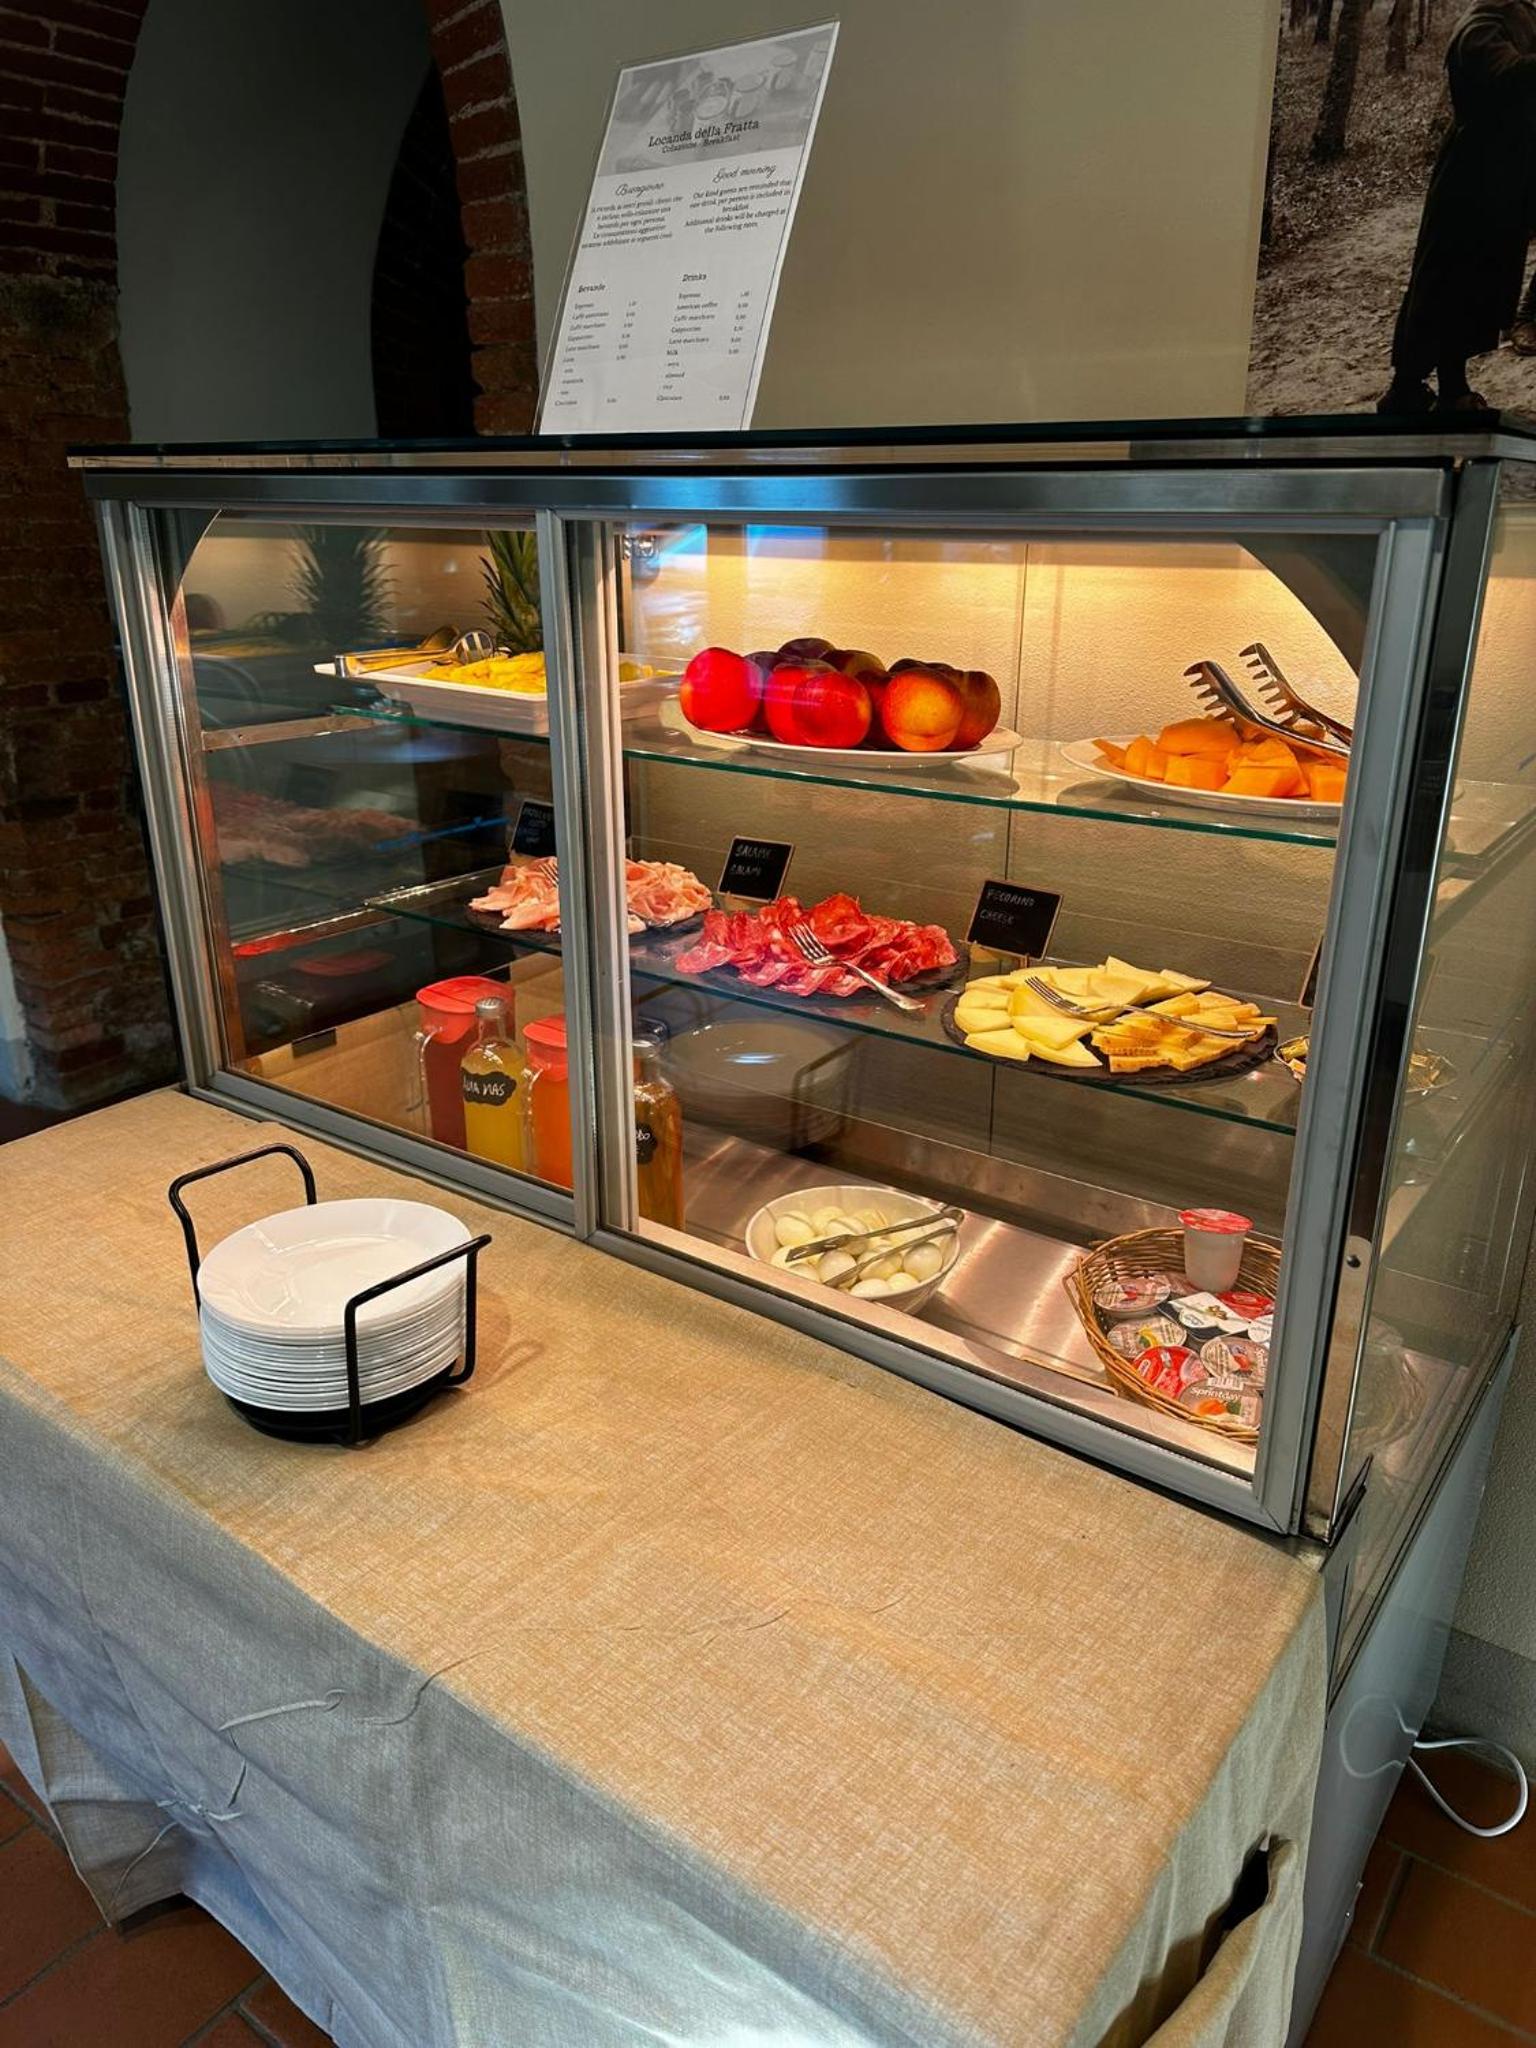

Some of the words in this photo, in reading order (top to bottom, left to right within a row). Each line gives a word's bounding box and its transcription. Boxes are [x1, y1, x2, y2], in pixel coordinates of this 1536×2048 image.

[648, 131, 693, 147] Locanda
[695, 126, 721, 139] della
[724, 120, 759, 134] Fratta
[712, 166, 740, 183] Good
[682, 272, 707, 282] Drinks
